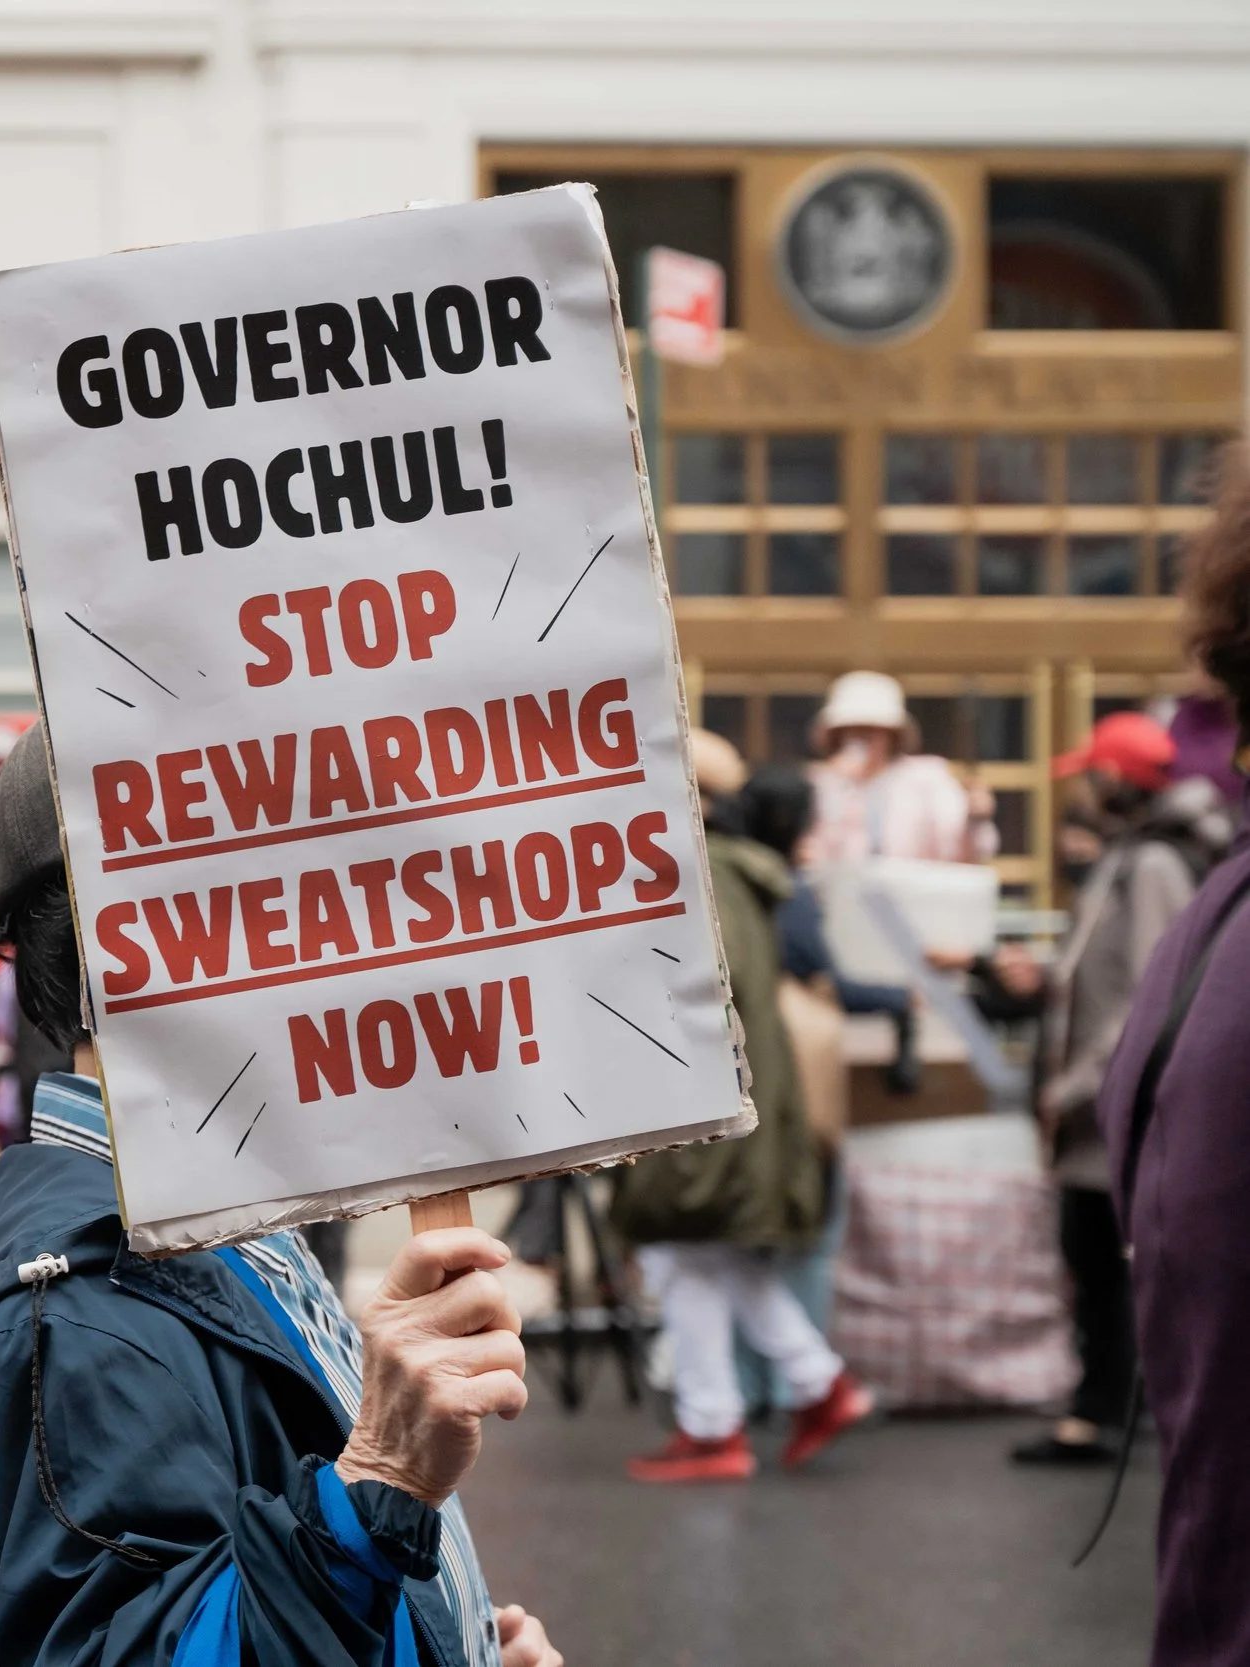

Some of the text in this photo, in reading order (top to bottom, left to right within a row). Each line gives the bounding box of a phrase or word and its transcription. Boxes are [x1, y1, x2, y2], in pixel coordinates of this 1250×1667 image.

[56, 276, 551, 429] GOVERNOR
[134, 419, 513, 561] HOCHUL!
[239, 569, 457, 688] STOP
[92, 678, 640, 853] REWARDING
[95, 811, 680, 996] SWEATSHOPS
[288, 976, 540, 1105] NOW!
